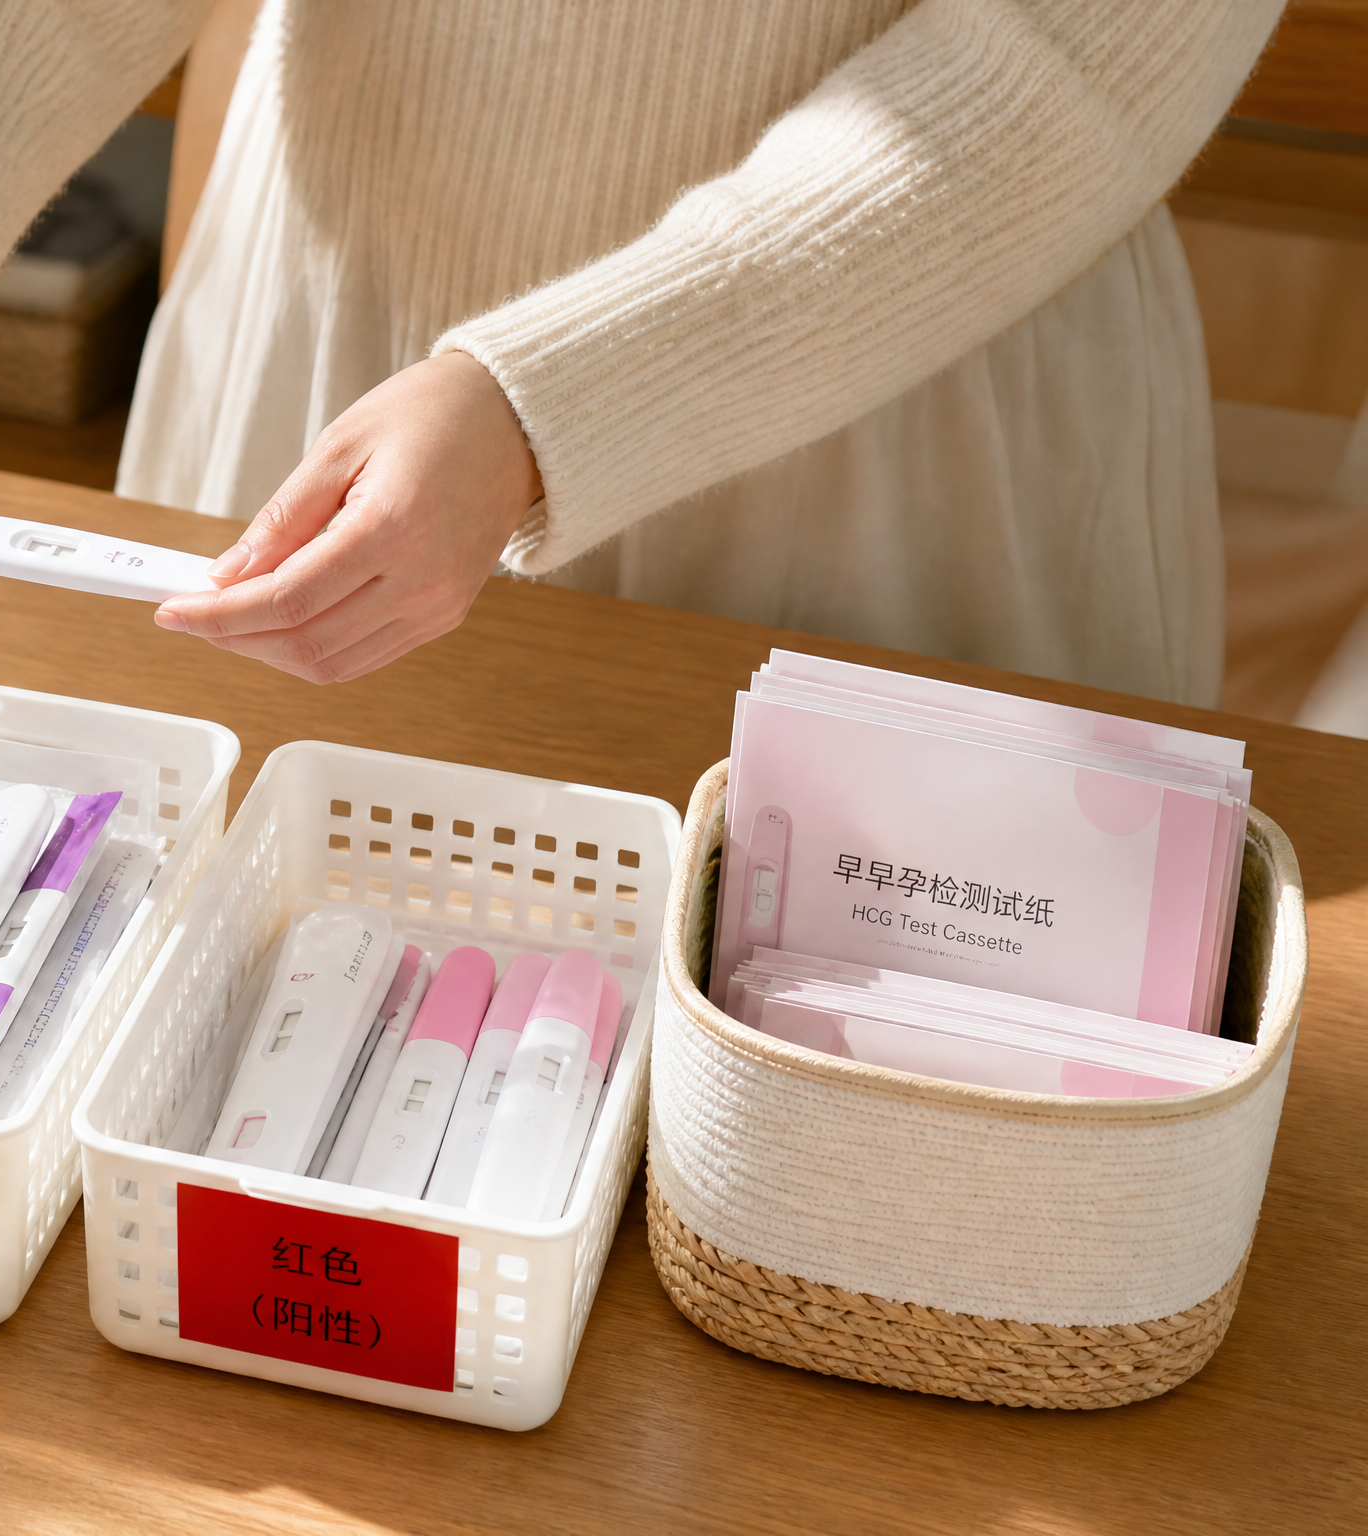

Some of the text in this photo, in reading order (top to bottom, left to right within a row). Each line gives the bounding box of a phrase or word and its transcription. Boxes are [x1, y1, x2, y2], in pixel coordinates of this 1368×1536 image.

[833, 853, 1055, 928] 早早孕检测试纸
[851, 903, 893, 926] HCG
[899, 913, 938, 937] Test
[943, 924, 1023, 955] Cassette
[271, 1236, 363, 1287] 红色
[252, 1293, 381, 1350] （阳性）
